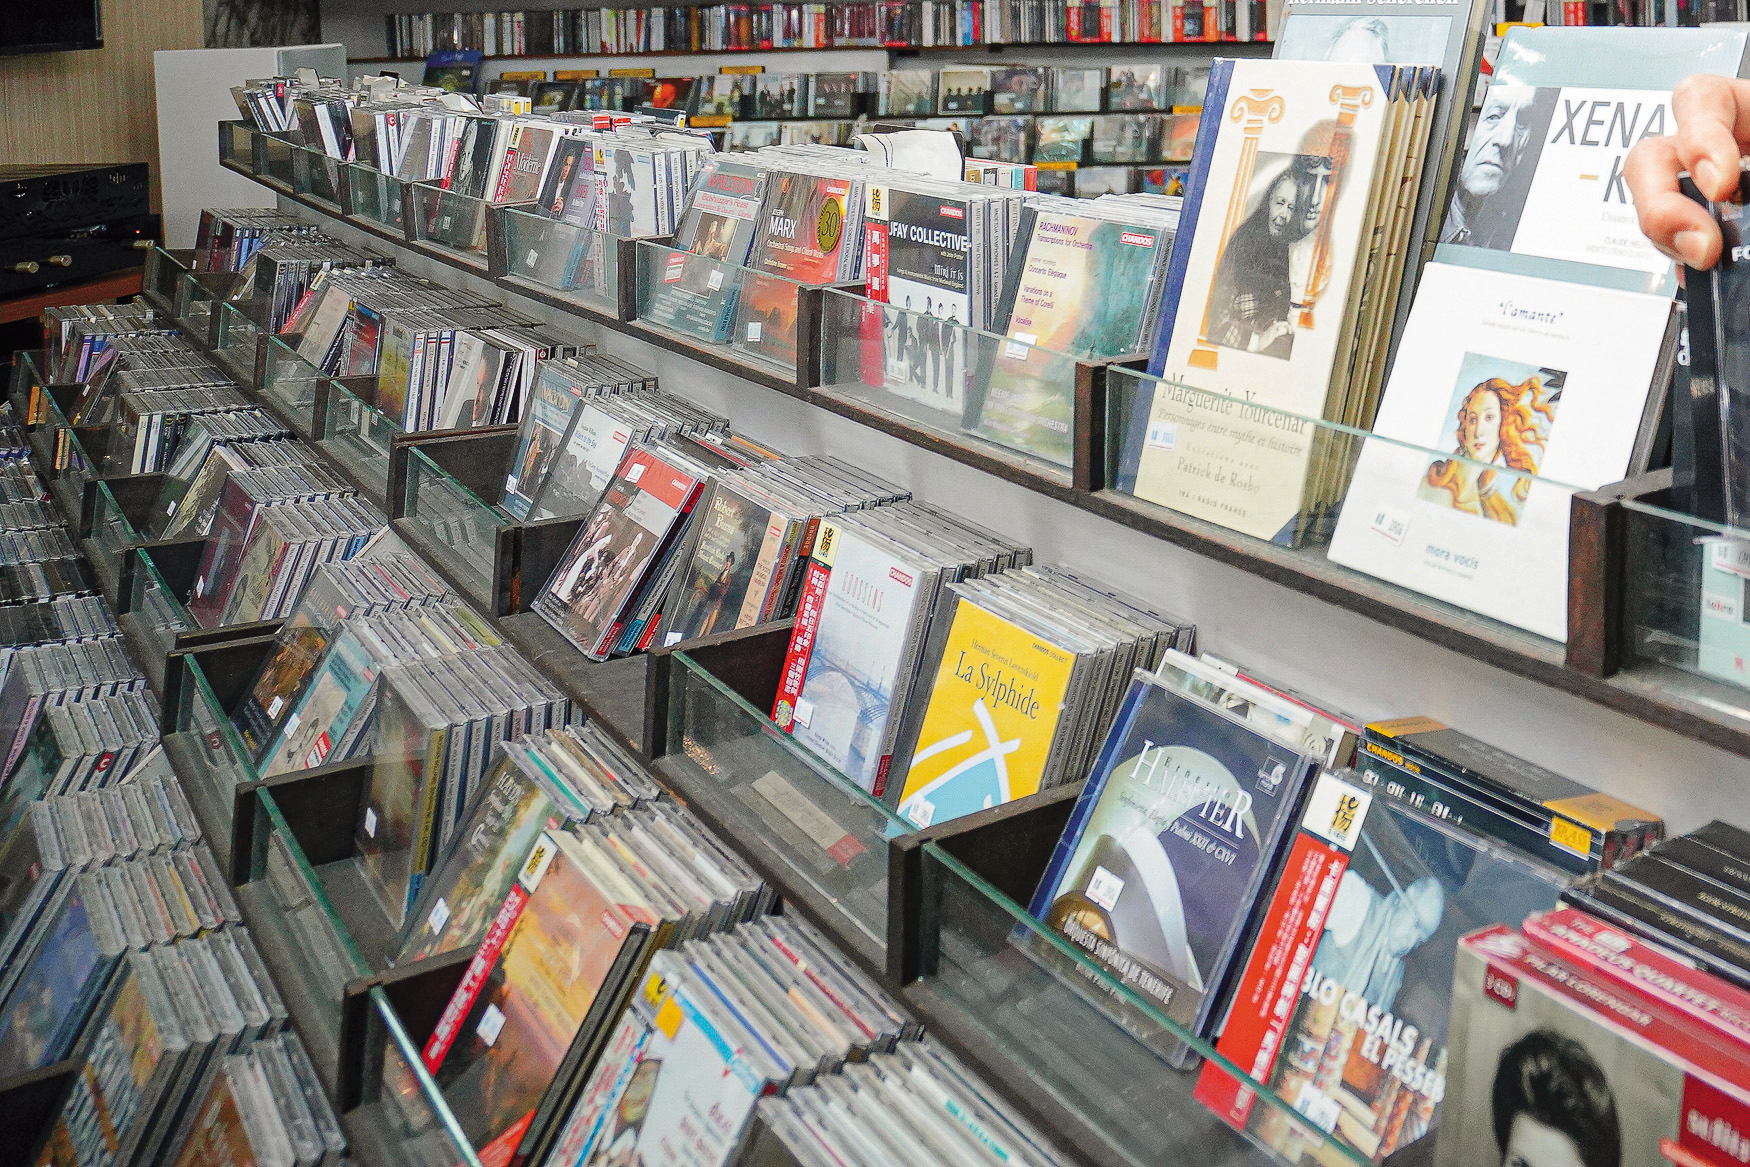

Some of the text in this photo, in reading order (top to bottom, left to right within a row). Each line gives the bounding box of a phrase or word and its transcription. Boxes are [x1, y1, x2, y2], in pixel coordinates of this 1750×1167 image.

[707, 174, 753, 194] WALTON
[1603, 156, 1632, 204] K
[769, 216, 797, 239] MARX
[821, 211, 838, 238] 30
[1039, 221, 1079, 236] RACHMANINOV
[910, 225, 968, 252] COLLECTIVE
[1121, 233, 1154, 247] CHANDOS
[1162, 373, 1308, 435] Marguerite Yourcenar
[1207, 423, 1228, 435] entre
[1256, 436, 1266, 444] et
[1177, 457, 1260, 494] Patrick de Rosbo
[1425, 543, 1451, 561] mora
[1453, 551, 1480, 570] vocis
[889, 567, 914, 588] CHANDOS
[842, 571, 884, 613] GOOSSENS
[954, 650, 1040, 720] La Sylphide
[1366, 742, 1404, 767] CHANDOS
[1550, 924, 1632, 971] AMADEUS
[1632, 962, 1719, 1012] QUARTET
[1525, 954, 1654, 1027] PILAR LORENGAR
[1302, 968, 1419, 1052] BLO CASALS
[1361, 1035, 1380, 1064] EL
